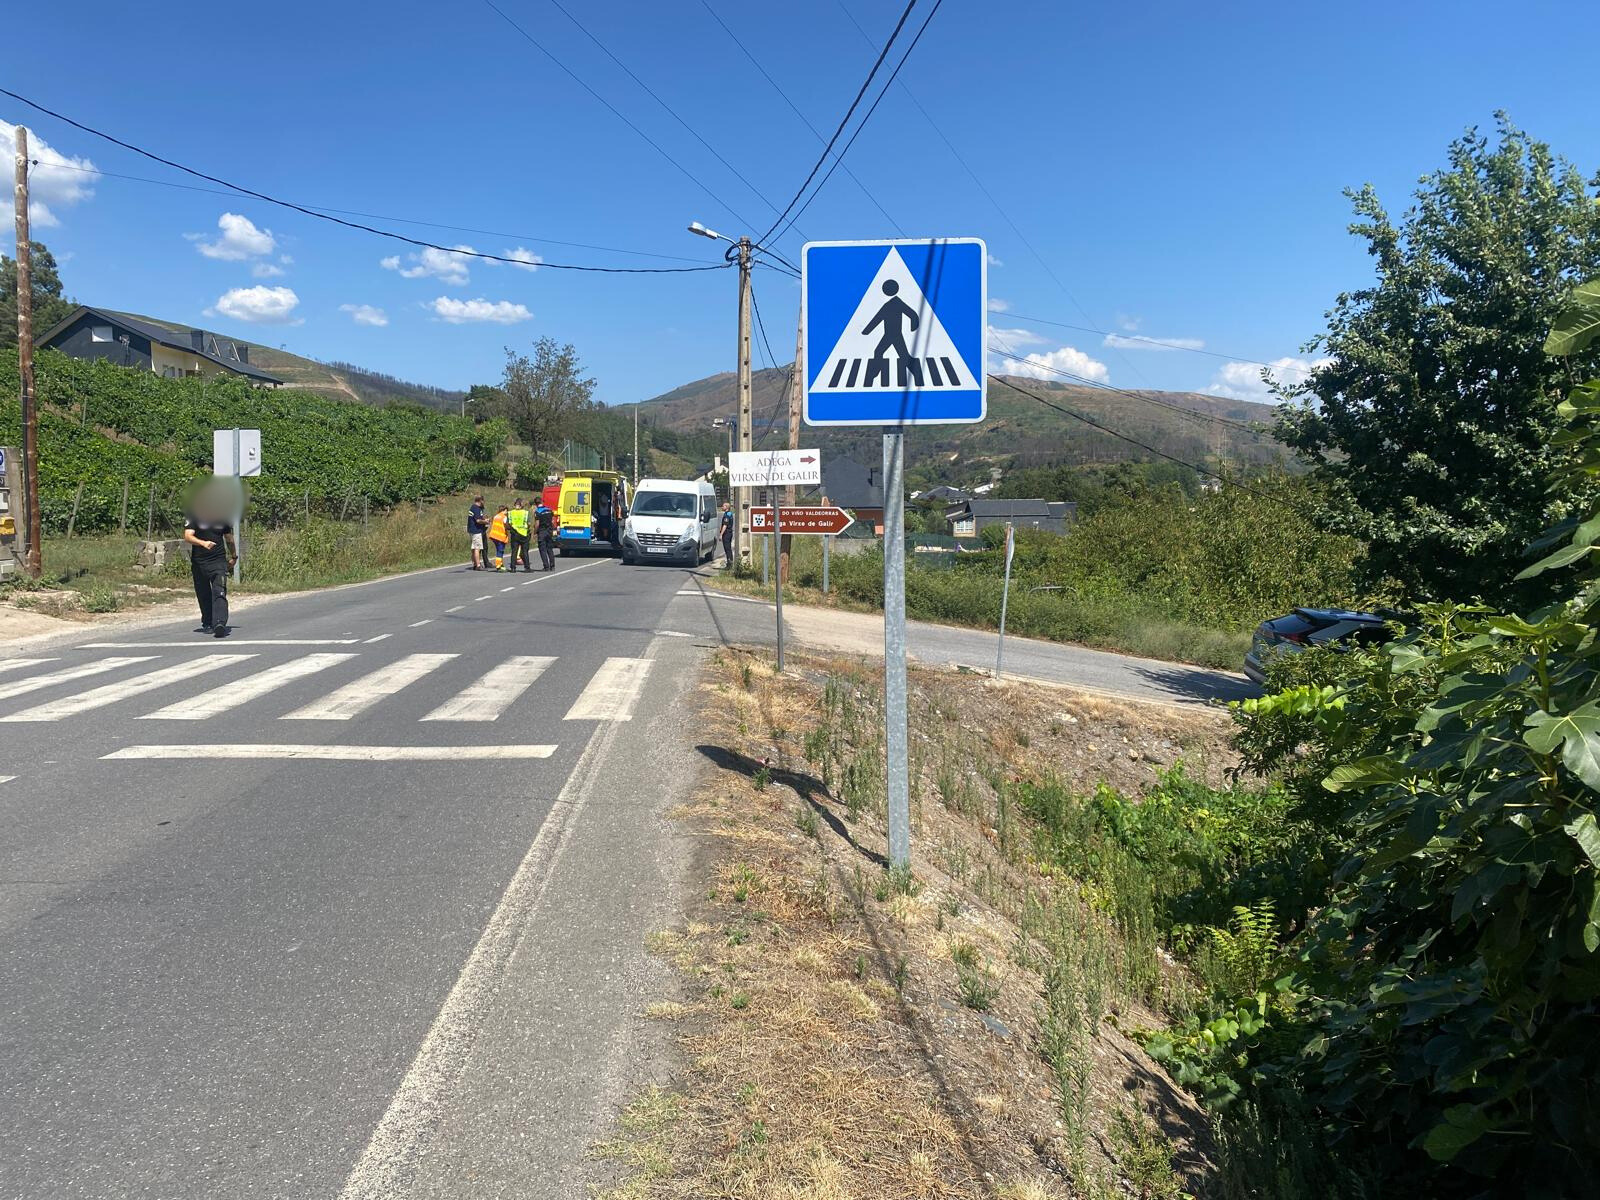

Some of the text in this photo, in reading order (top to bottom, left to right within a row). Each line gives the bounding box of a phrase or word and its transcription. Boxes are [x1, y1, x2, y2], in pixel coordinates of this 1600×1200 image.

[757, 457, 792, 466] ADEGA
[731, 471, 818, 482] VIRXEN DE GALIR
[570, 505, 584, 513] 061
